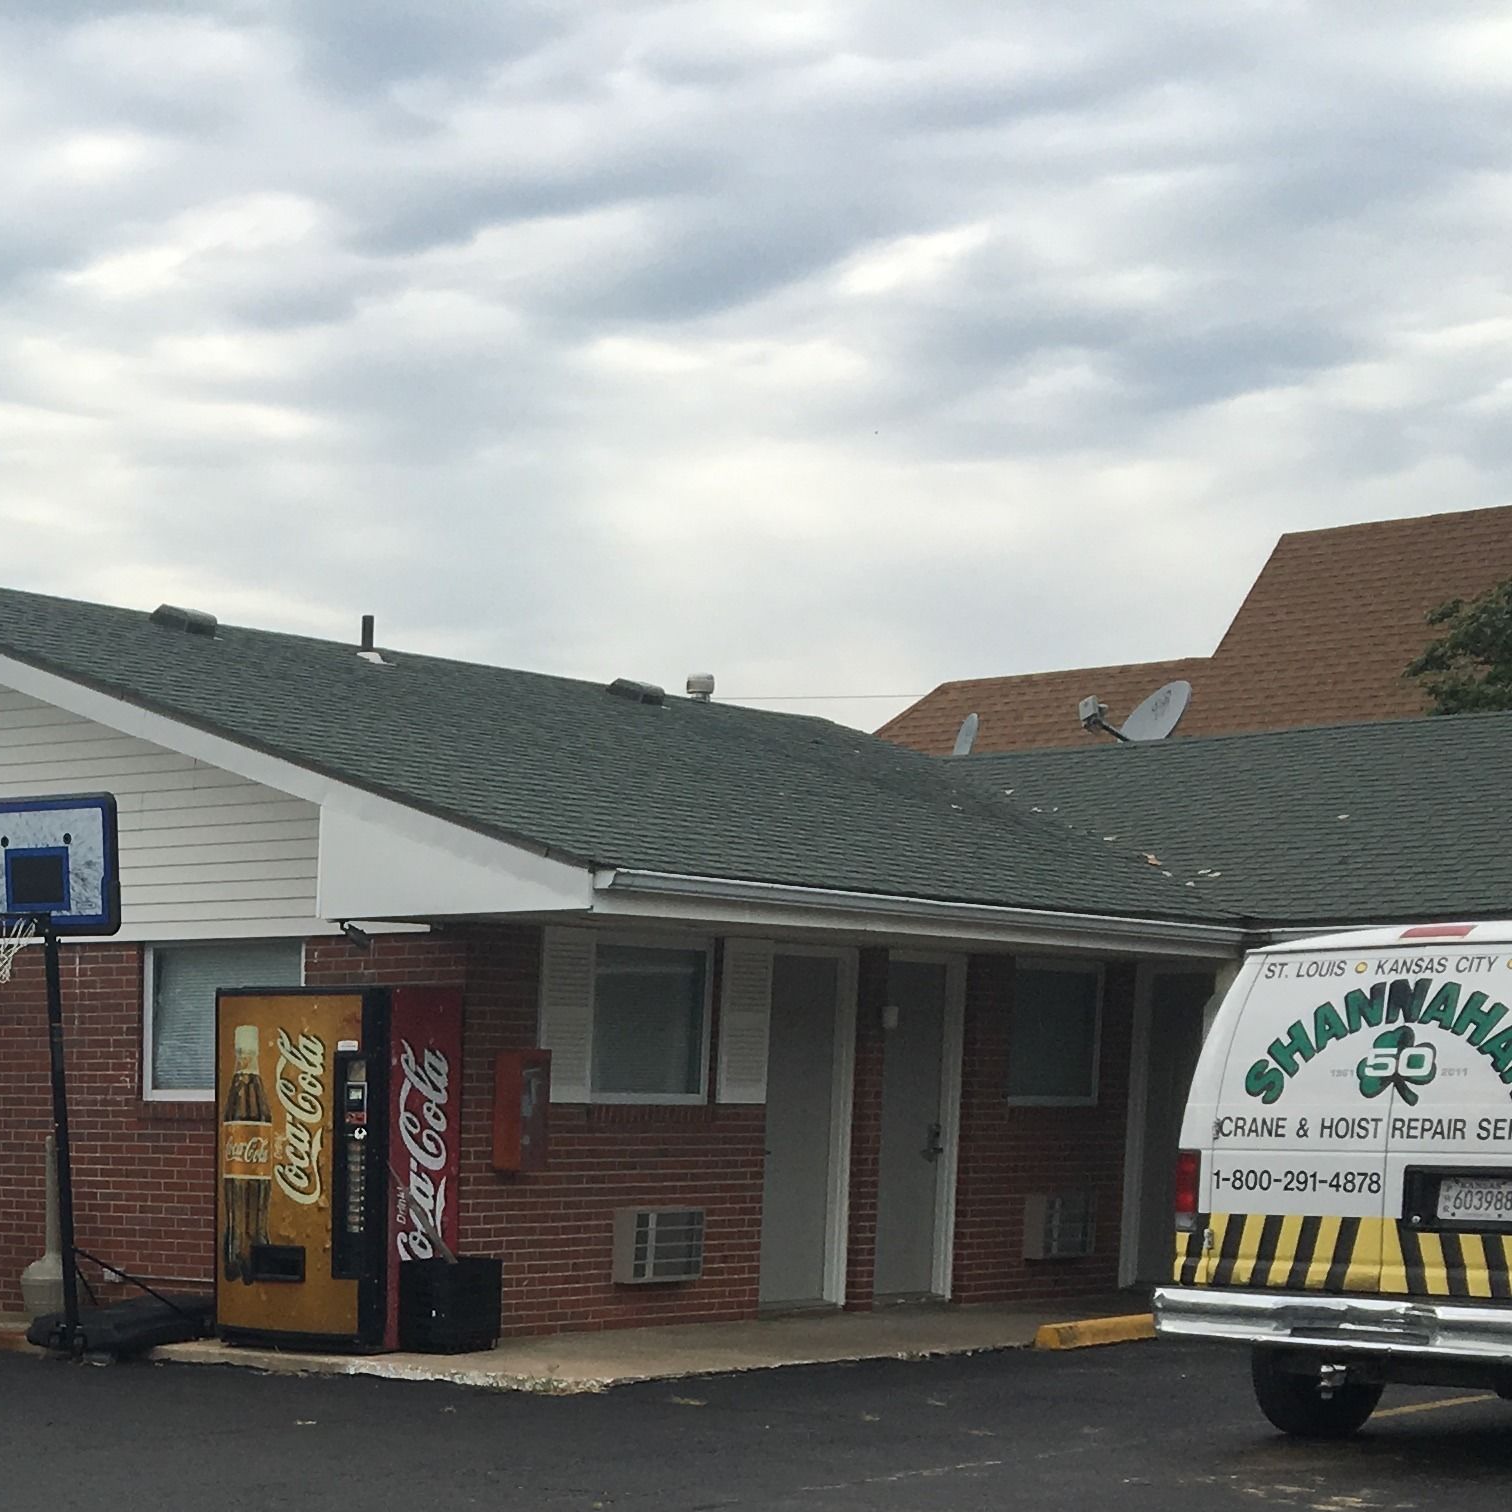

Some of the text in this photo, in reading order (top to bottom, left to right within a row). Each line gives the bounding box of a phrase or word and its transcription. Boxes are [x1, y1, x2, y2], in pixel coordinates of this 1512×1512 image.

[1264, 956, 1499, 979] ST. LOUIS KANSAS CITY
[1245, 978, 1512, 1105] SHANNAHA
[1365, 1048, 1434, 1077] 50
[1219, 1117, 1287, 1139] CRANE
[1296, 1118, 1310, 1139] &
[1320, 1117, 1383, 1140] HOIST
[1391, 1118, 1467, 1140] REPAIR
[1213, 1170, 1381, 1194] 1-800-291-4878
